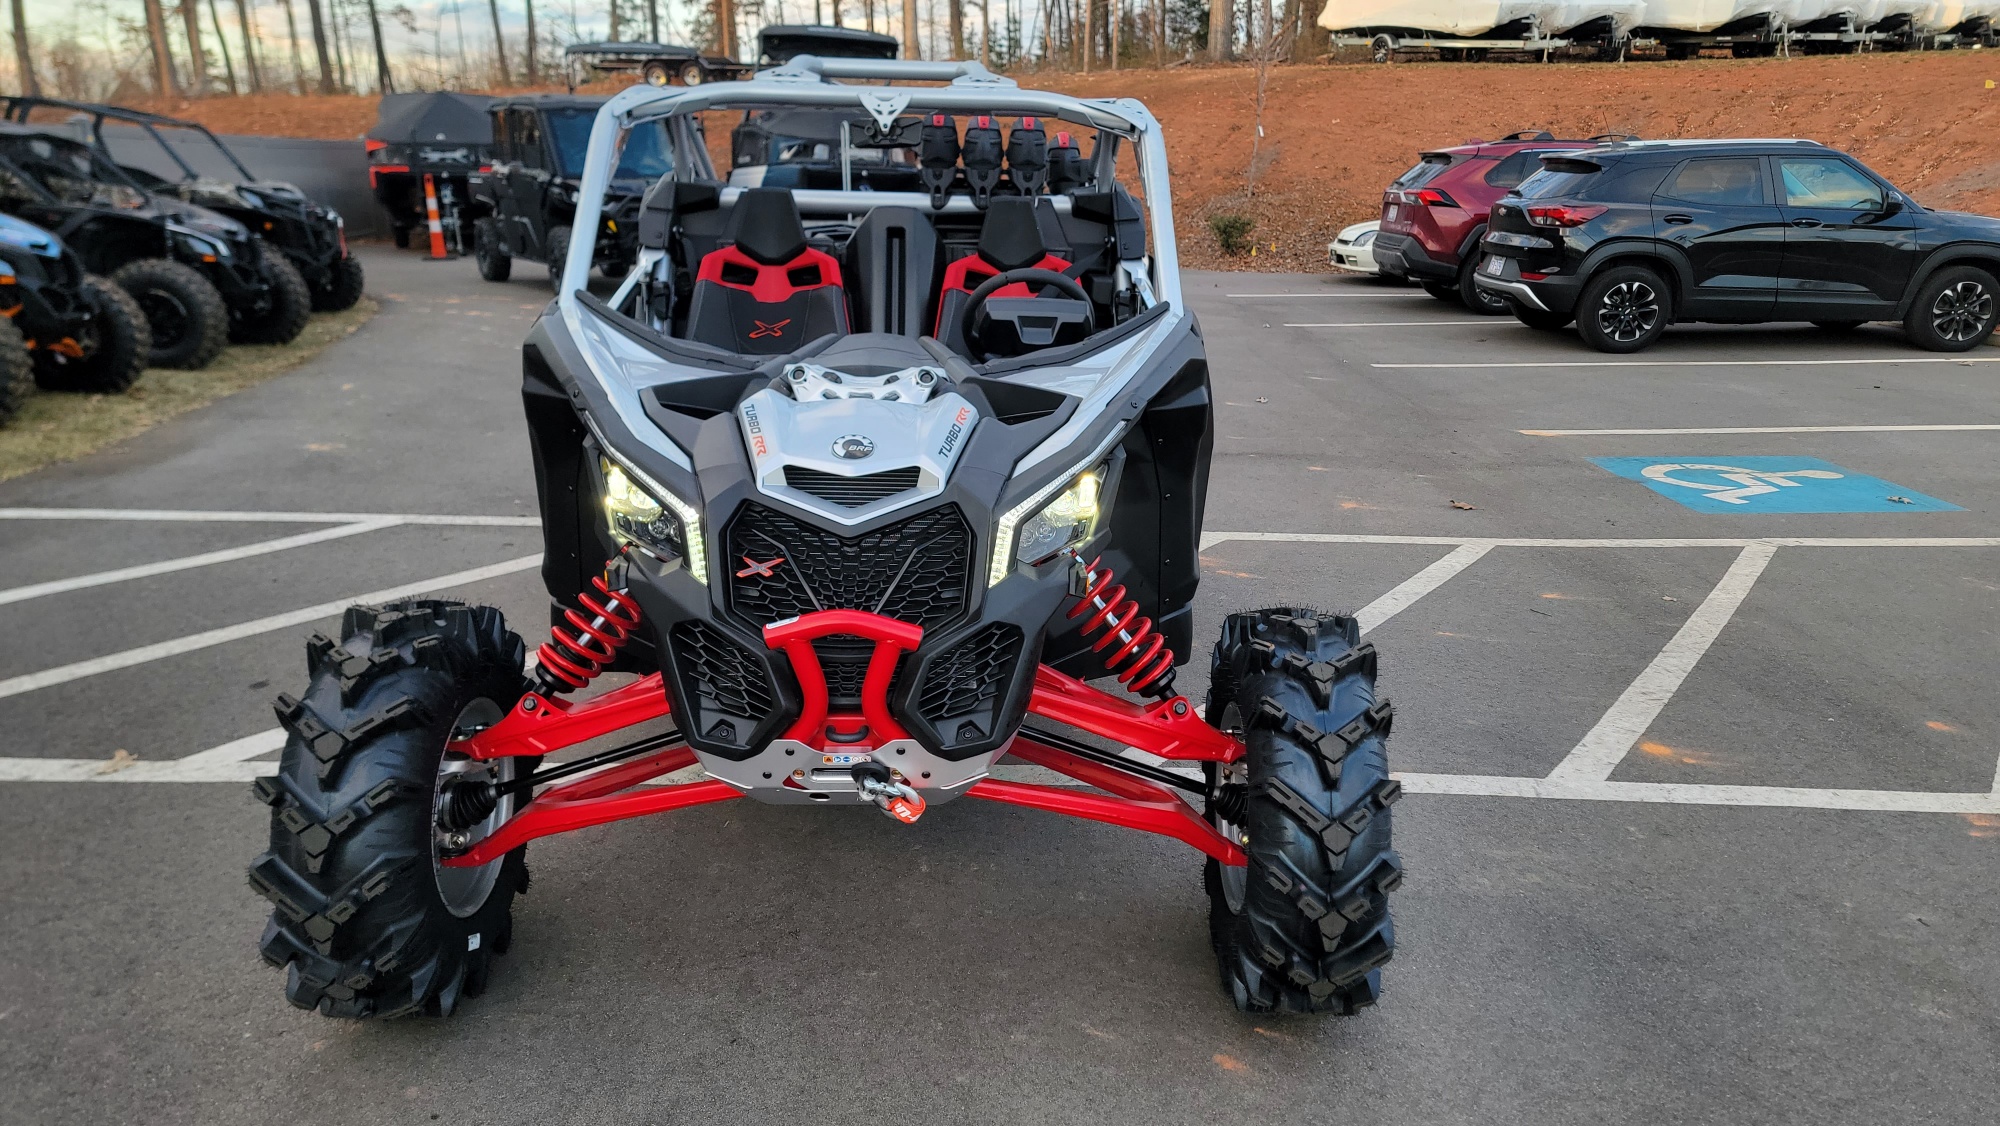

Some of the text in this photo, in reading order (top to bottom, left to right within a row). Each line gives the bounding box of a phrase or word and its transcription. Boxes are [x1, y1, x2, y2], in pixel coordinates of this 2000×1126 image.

[744, 403, 767, 456] TURBO RR
[938, 407, 970, 458] TURBO RR
